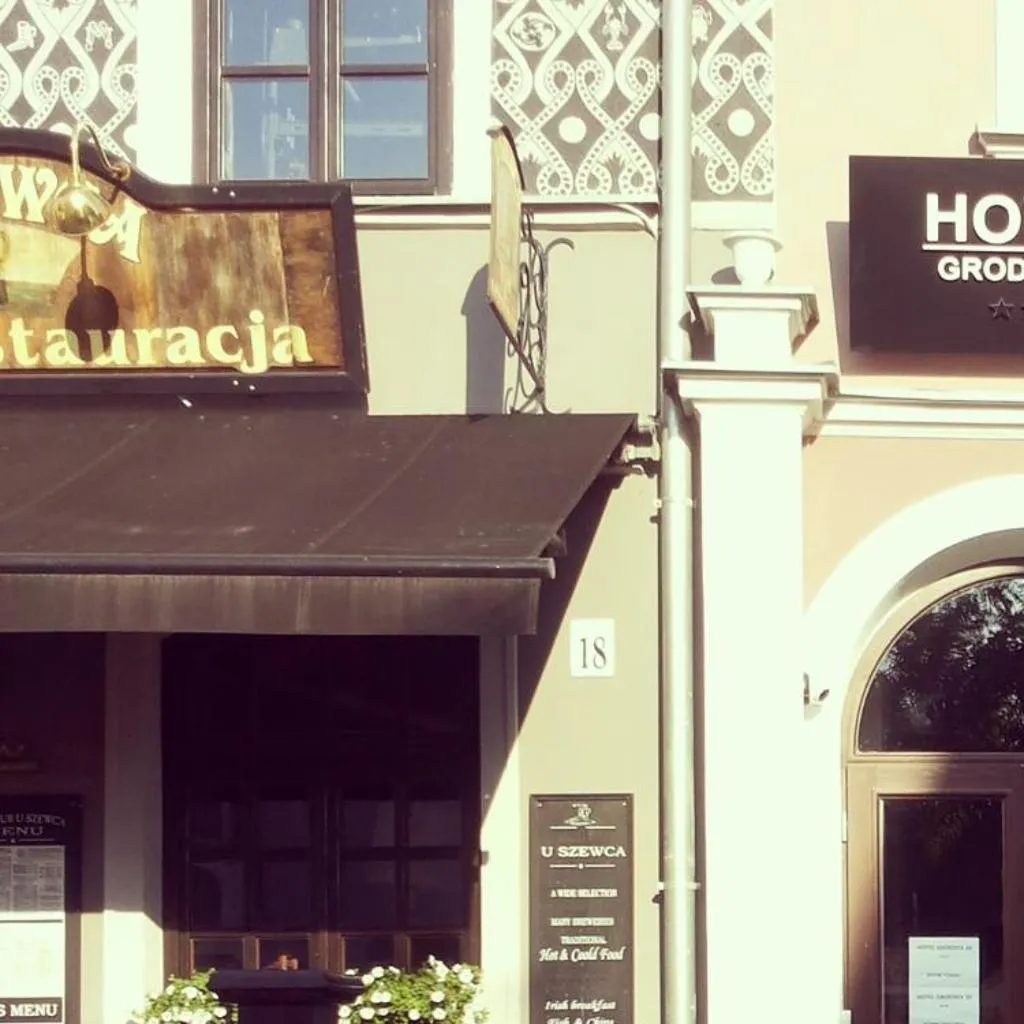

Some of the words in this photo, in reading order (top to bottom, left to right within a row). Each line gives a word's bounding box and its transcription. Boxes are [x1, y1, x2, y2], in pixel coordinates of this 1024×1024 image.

[0, 163, 147, 264] WA
[0, 310, 314, 374] tauracja
[580, 636, 607, 669] 18
[541, 846, 553, 857] U
[557, 846, 627, 857] SZEWCA
[10, 1003, 59, 1017] MENU
